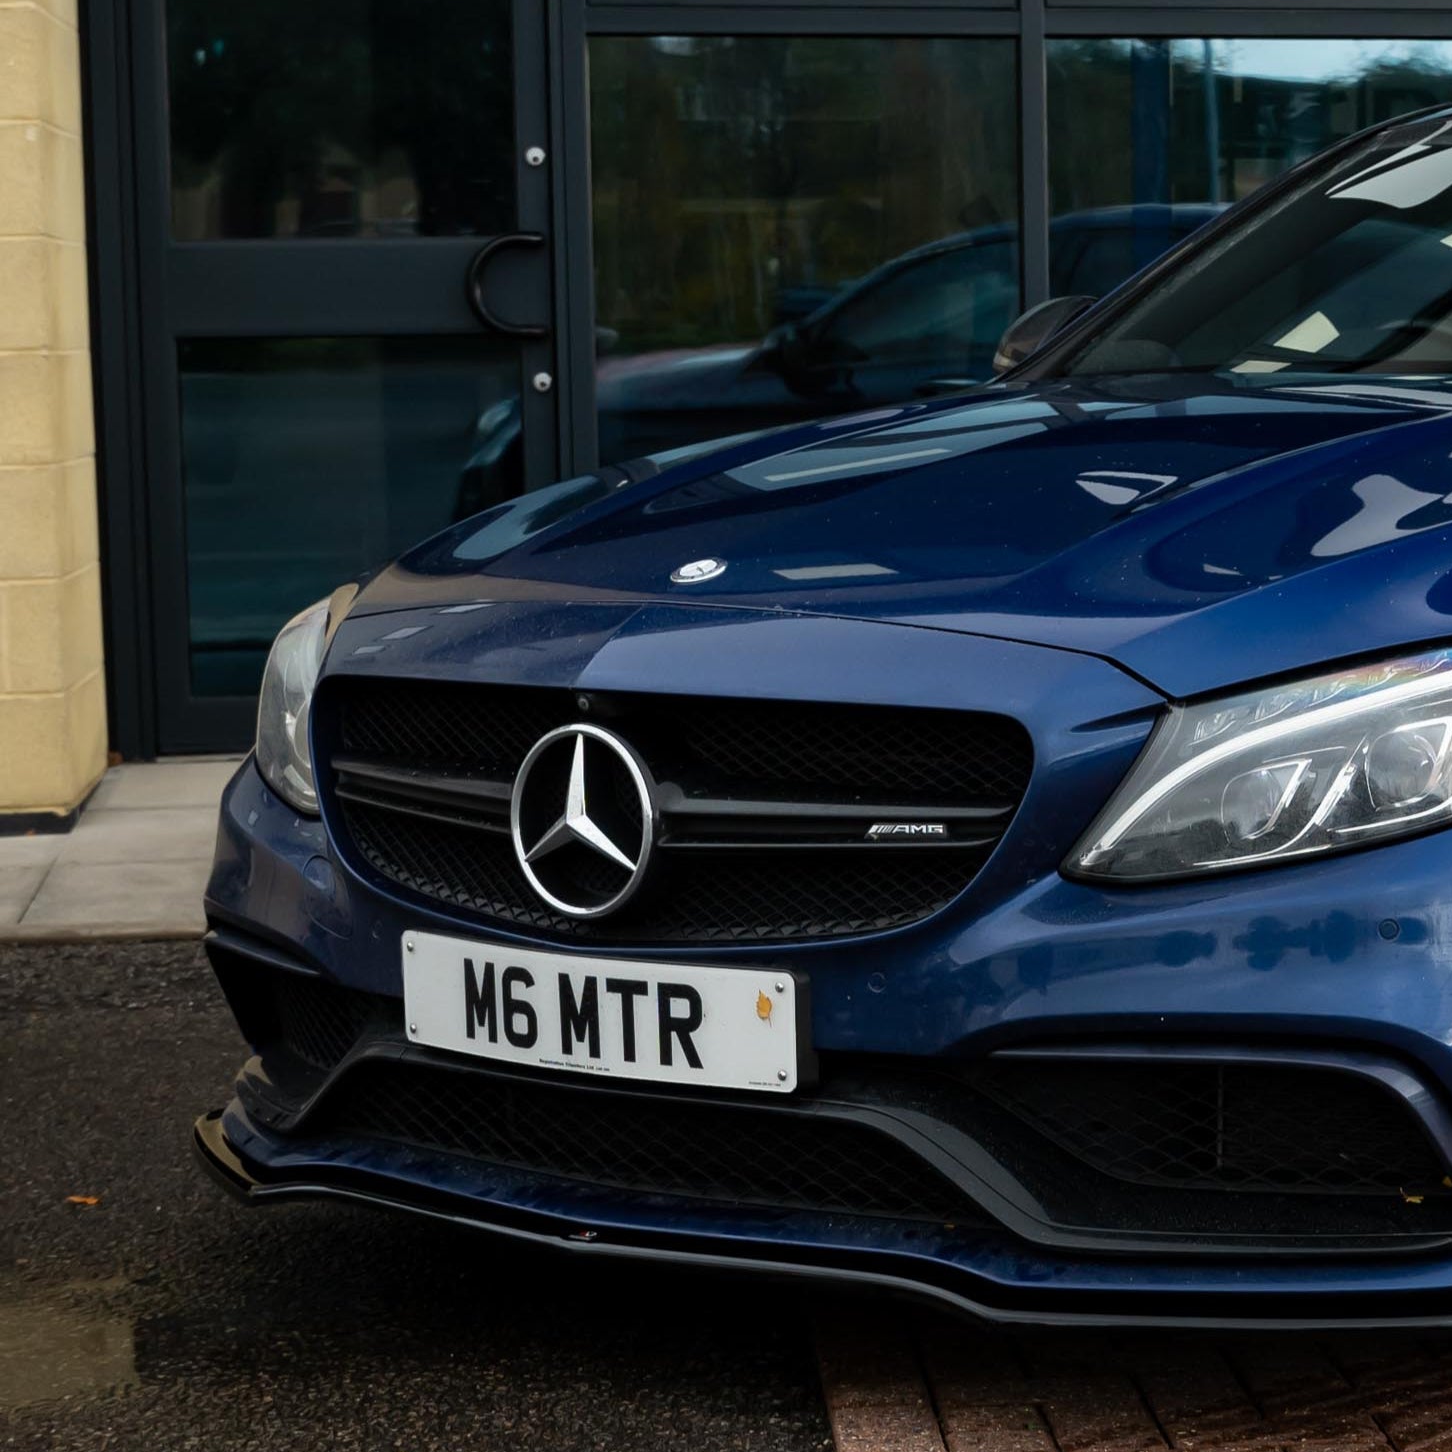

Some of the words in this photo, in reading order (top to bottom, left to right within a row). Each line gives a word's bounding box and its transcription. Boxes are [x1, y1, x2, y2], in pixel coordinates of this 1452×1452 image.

[892, 824, 944, 834] AMG
[463, 957, 538, 1049] M6
[558, 972, 704, 1070] MTR
